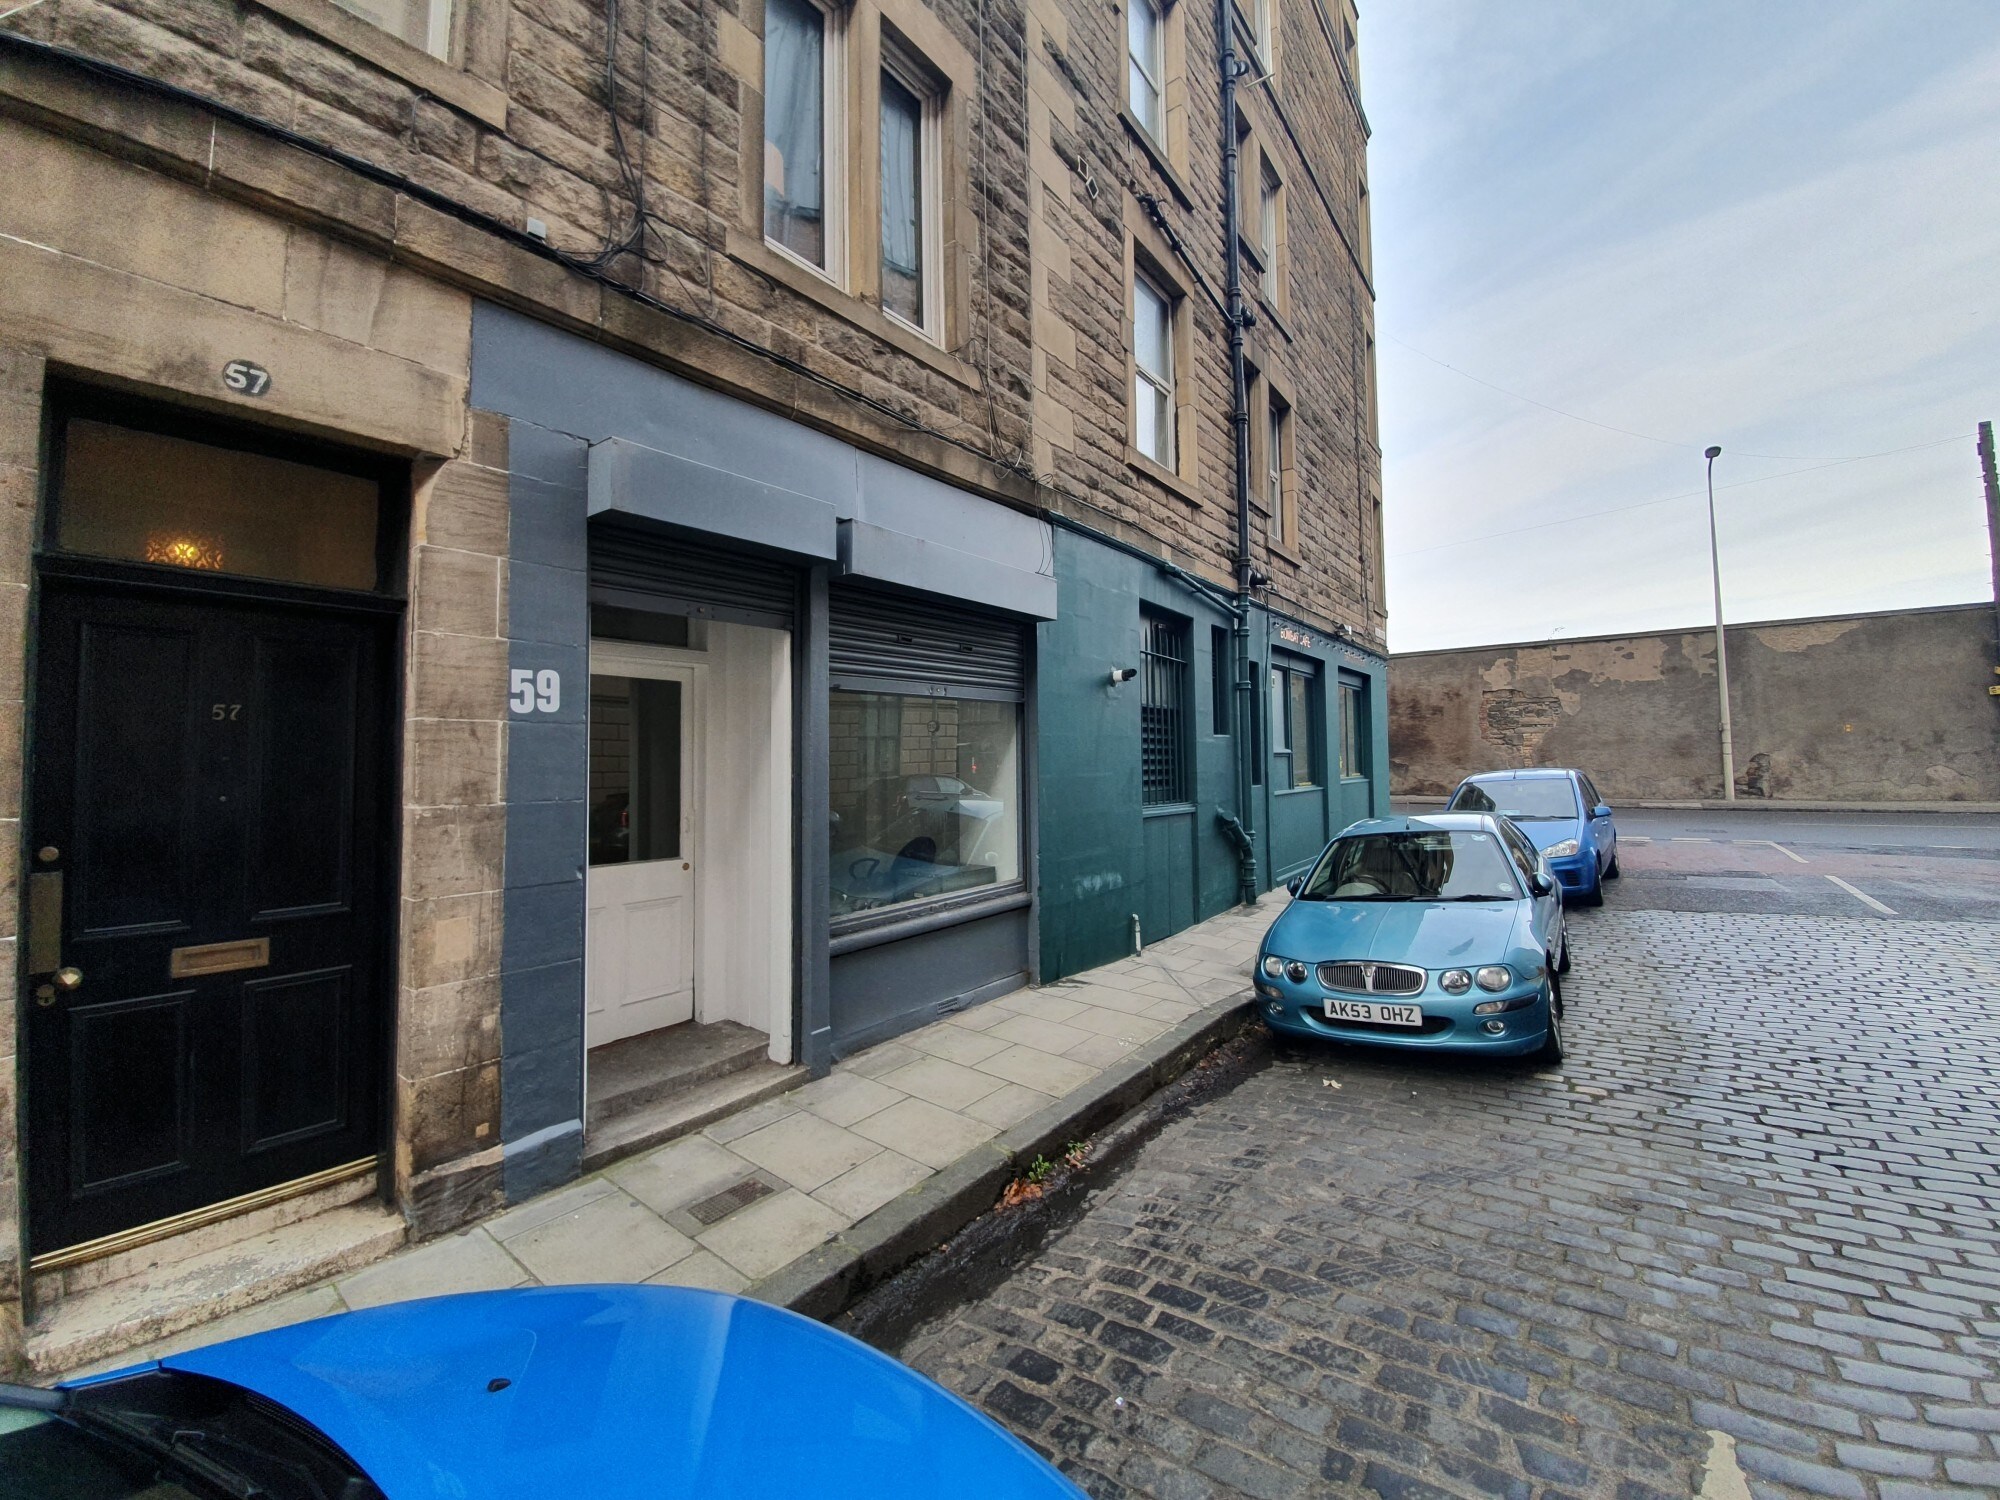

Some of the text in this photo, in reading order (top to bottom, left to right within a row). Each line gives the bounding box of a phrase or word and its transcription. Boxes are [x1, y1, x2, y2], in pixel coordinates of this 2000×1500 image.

[225, 363, 268, 393] 57
[510, 669, 560, 713] 59
[212, 704, 242, 720] 57
[1330, 1001, 1415, 1022] AK53 OHZ
